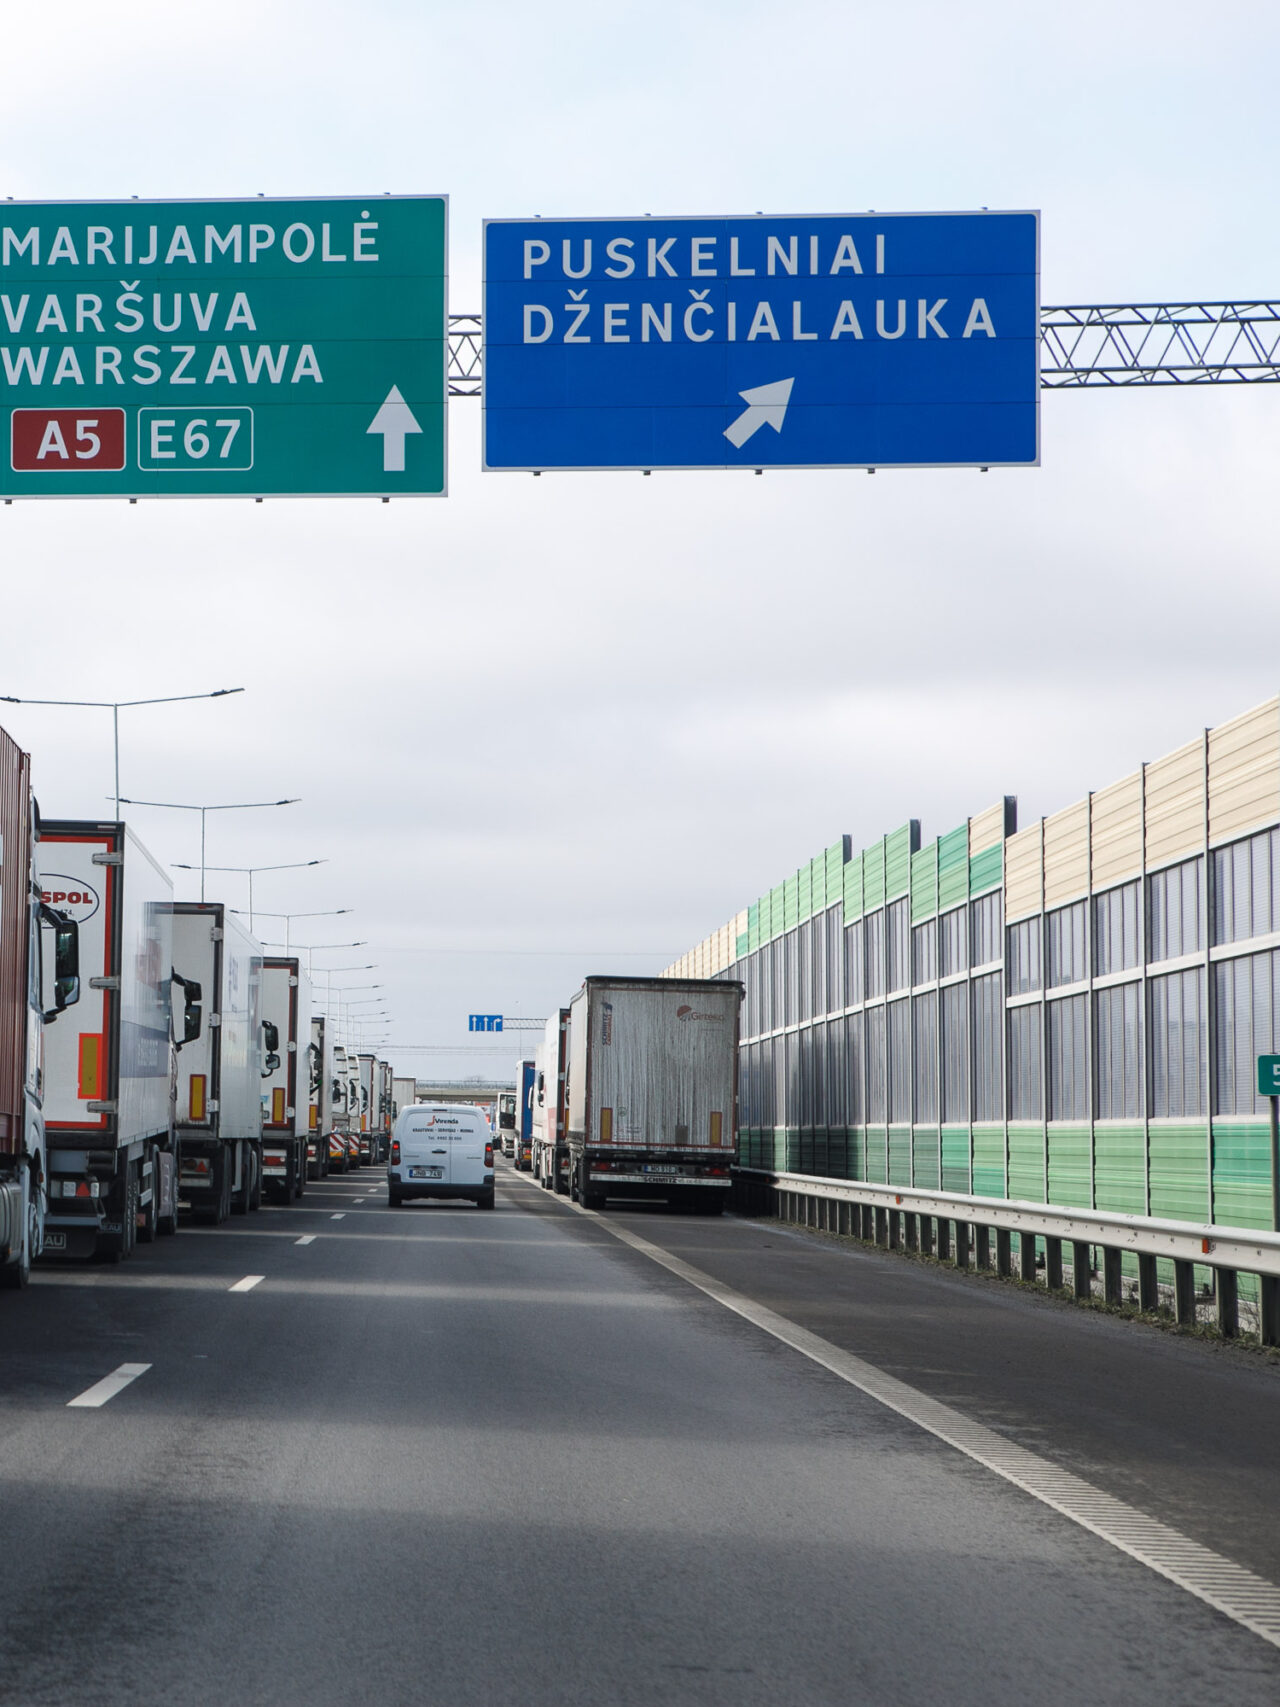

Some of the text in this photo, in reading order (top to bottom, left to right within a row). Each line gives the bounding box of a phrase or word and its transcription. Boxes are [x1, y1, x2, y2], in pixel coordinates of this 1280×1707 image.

[2, 210, 380, 266] MARIJAMPOLĖ
[523, 234, 885, 279] PUSKELNIAI
[0, 280, 257, 333] VARŠUVA
[523, 289, 997, 344] DŽENČIALAUKA
[0, 344, 324, 386] WARSZAWA
[36, 420, 101, 460] A5
[150, 419, 241, 459] E67
